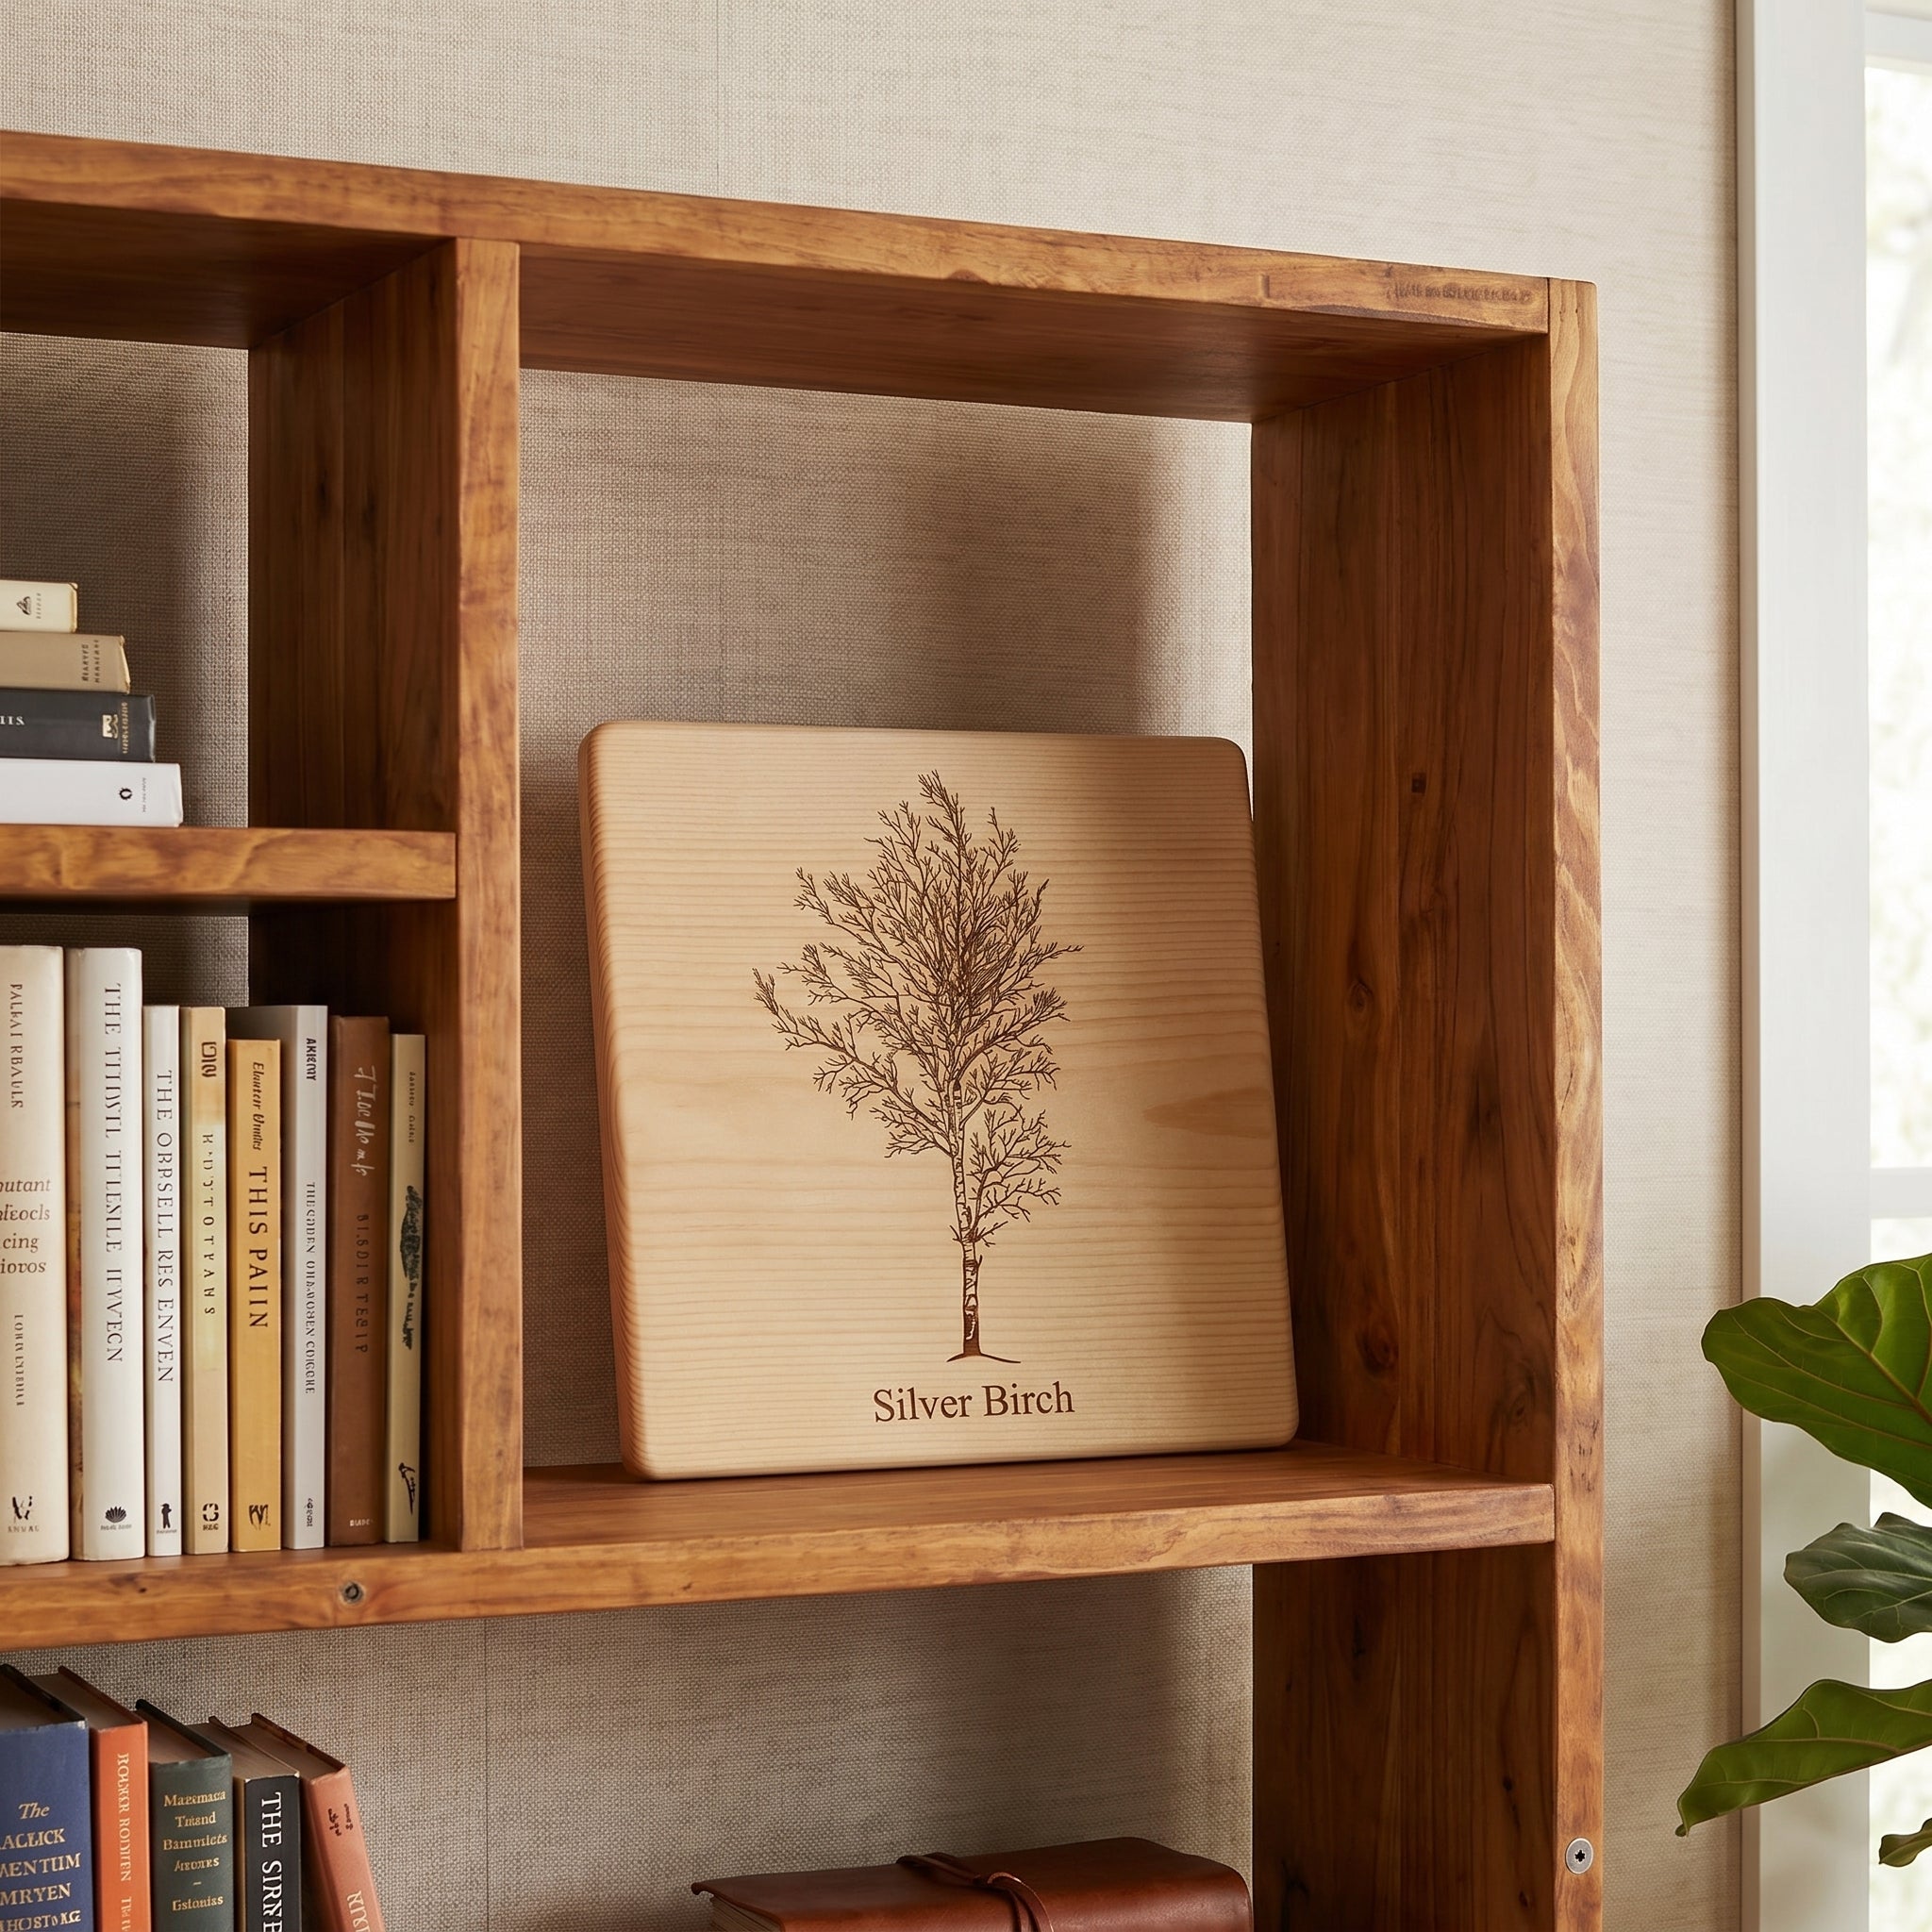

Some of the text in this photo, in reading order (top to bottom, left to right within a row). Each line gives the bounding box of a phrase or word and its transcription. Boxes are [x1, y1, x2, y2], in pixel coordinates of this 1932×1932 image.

[105, 983, 122, 1035] THE
[157, 1070, 174, 1121] THE
[158, 1250, 175, 1287] RES
[249, 1166, 269, 1328] THIS PAIIN
[158, 1298, 175, 1381] ENVEN
[874, 1380, 1075, 1423] Silver Birch
[18, 1802, 51, 1820] The
[260, 1791, 282, 1849] THE
